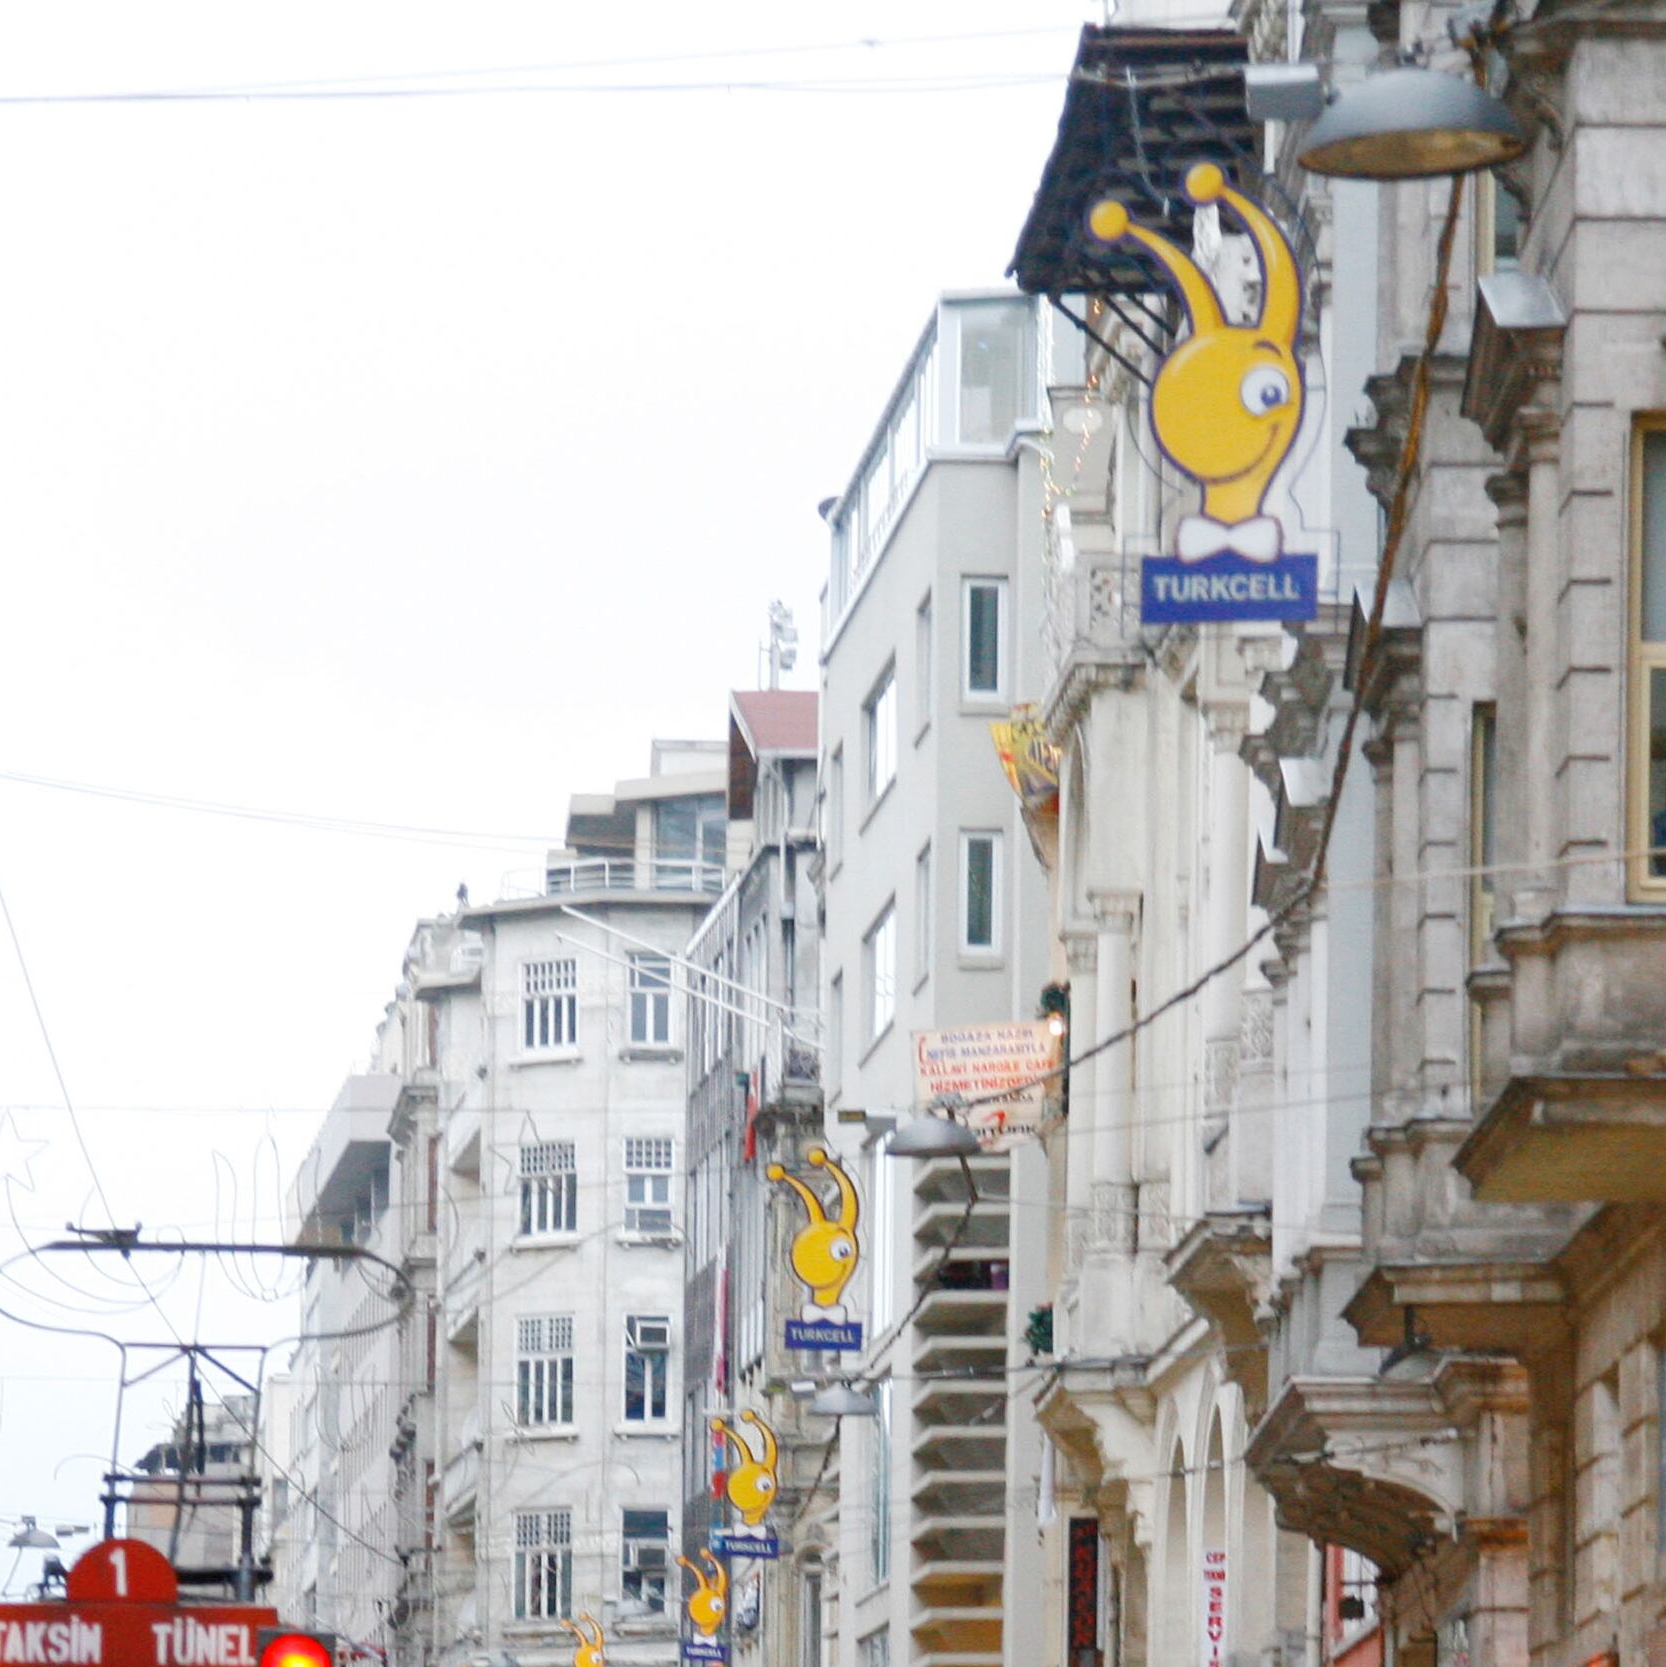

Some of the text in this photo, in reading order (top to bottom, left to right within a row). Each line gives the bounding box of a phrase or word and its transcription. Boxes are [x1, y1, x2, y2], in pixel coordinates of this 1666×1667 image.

[1153, 574, 1301, 602] TURKCELL
[109, 1547, 129, 1597] 1
[151, 1615, 257, 1667] TÜNEL
